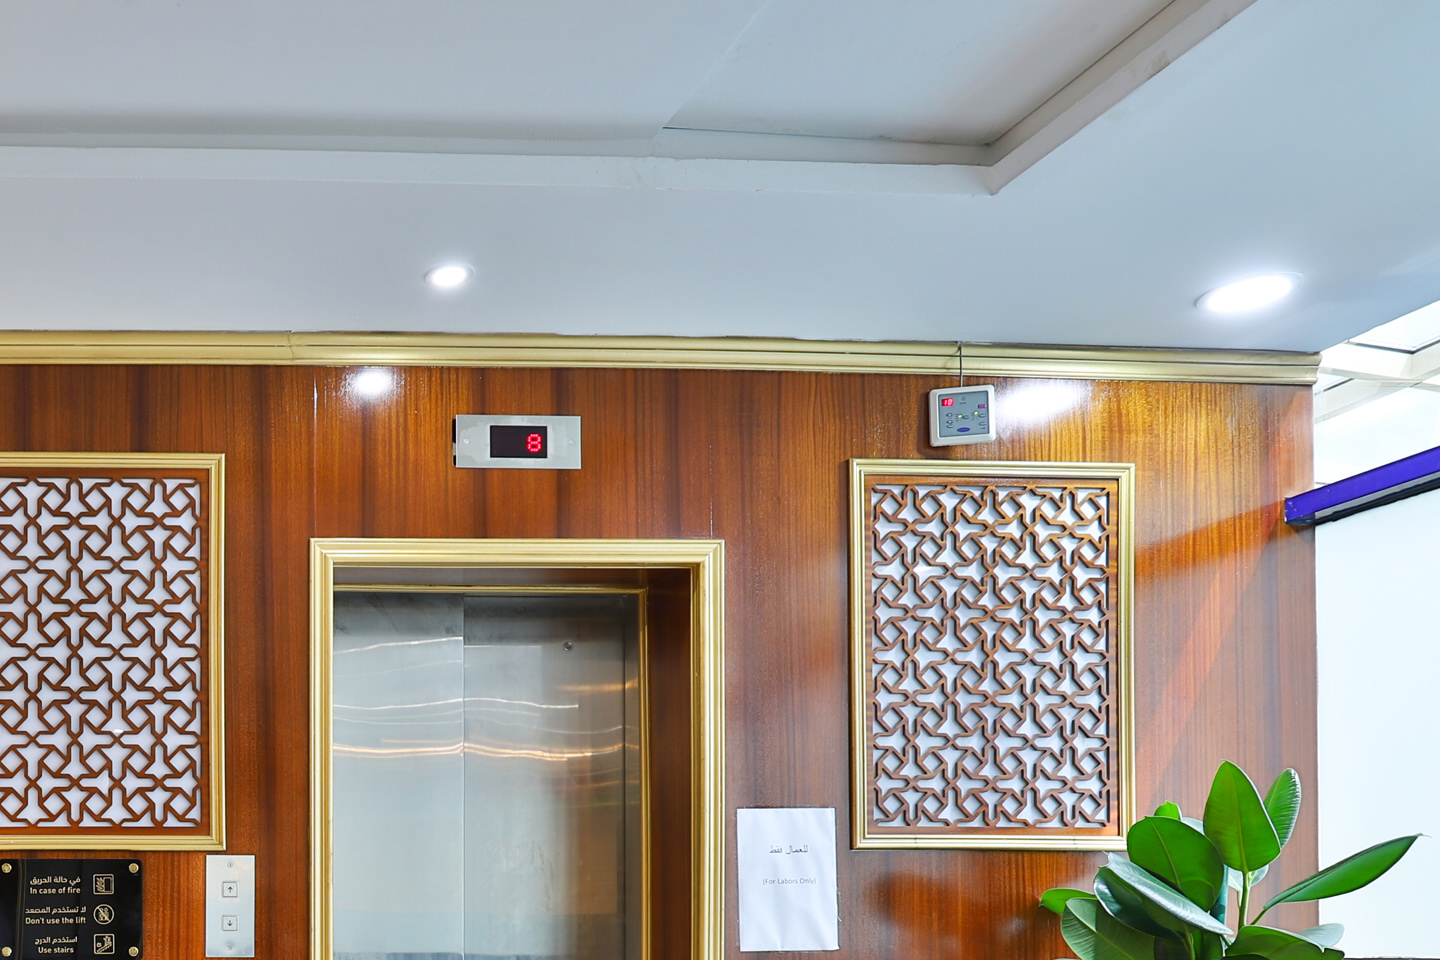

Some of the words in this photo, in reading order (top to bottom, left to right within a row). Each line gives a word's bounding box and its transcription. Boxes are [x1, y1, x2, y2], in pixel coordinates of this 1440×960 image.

[526, 433, 542, 453] 8
[769, 844, 783, 854] فقط
[785, 844, 809, 855] للعمال
[29, 876, 52, 886] الحريق
[53, 876, 68, 884] حالة
[68, 876, 81, 886] في
[762, 878, 776, 886] (For
[799, 877, 817, 885] Only)
[67, 886, 81, 894] fire
[25, 906, 51, 914] المصعد
[51, 906, 79, 915] تستخدم
[80, 905, 87, 913] لا
[25, 917, 45, 925] Don't
[75, 916, 86, 924] lift
[34, 936, 51, 945] الدرج
[51, 936, 78, 945] استخدم
[37, 946, 52, 954] Use
[53, 946, 74, 954] stairs
